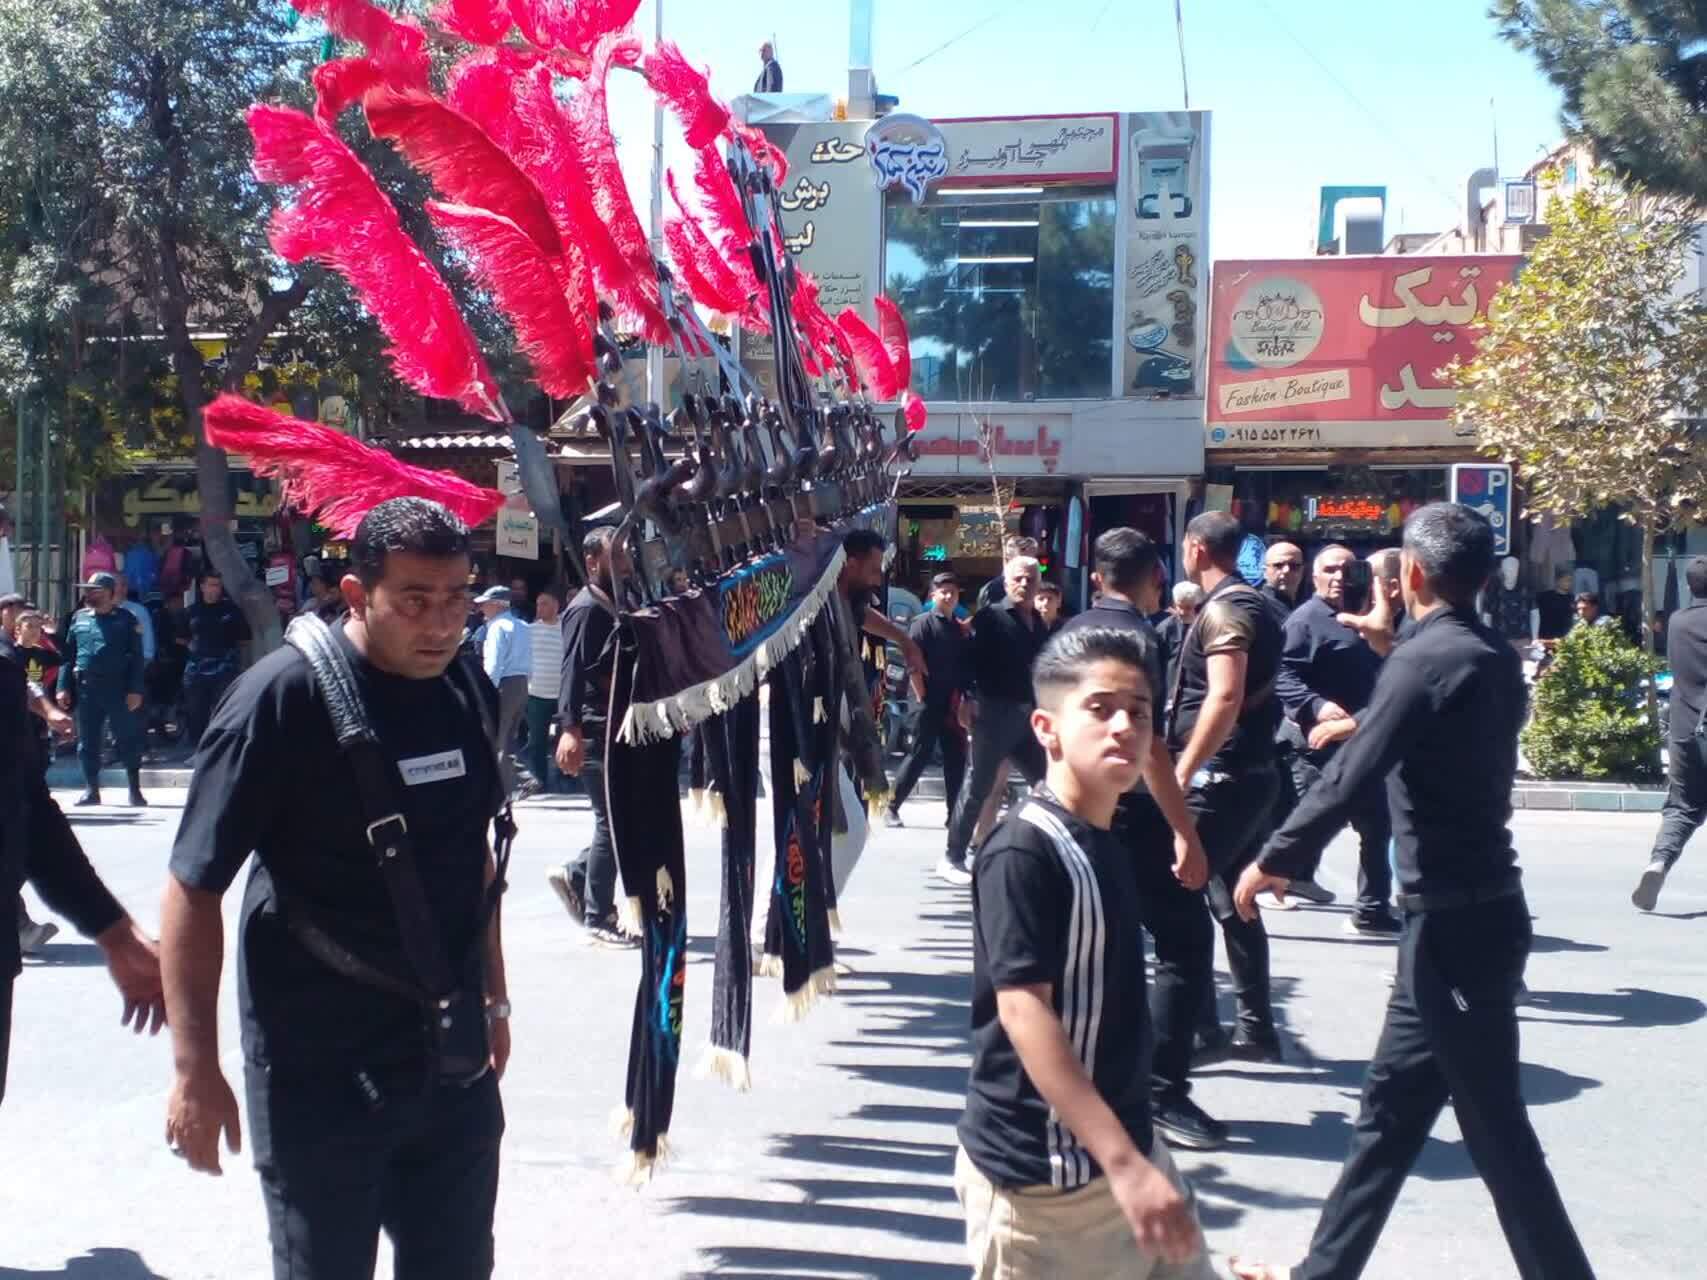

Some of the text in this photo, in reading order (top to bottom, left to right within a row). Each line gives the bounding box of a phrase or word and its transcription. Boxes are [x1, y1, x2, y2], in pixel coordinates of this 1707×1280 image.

[779, 176, 832, 212] برش
[1359, 266, 1500, 343] تیک
[1225, 378, 1345, 409] Fashion Boutique
[1487, 470, 1507, 496] P
